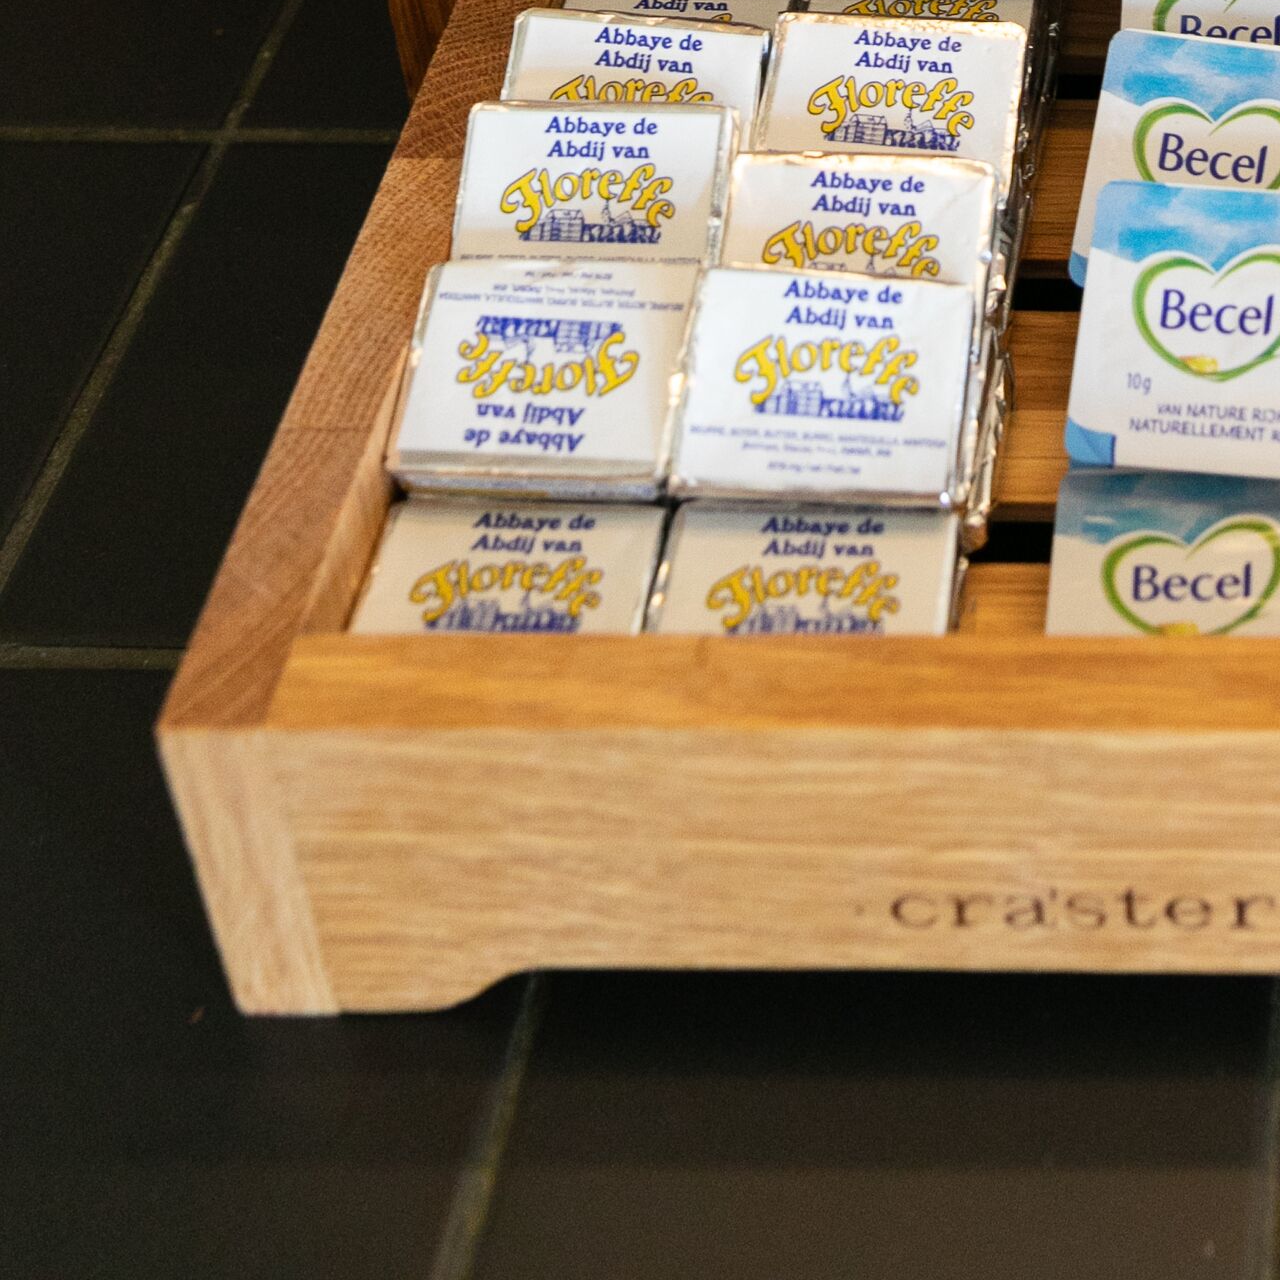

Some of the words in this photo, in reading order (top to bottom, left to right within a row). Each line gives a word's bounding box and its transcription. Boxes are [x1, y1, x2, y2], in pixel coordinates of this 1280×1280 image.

[693, 0, 729, 11] van
[594, 27, 673, 52] Abbaye
[679, 33, 703, 51] de
[854, 29, 932, 52] Abbaye
[938, 36, 962, 53] de
[594, 49, 652, 73] Abdij
[657, 59, 694, 74] van
[854, 51, 911, 74] Abdij
[917, 60, 954, 74] van
[545, 116, 627, 137] Abbaye
[632, 117, 659, 135] de
[547, 140, 606, 161] Abdij
[612, 145, 650, 159] van
[1158, 132, 1268, 185] Becel
[810, 170, 894, 194] Abbaye
[900, 175, 926, 193] de
[812, 193, 872, 217] Abdij
[878, 202, 917, 217] van
[783, 279, 869, 304] Abbaye
[877, 285, 903, 304] de
[785, 306, 847, 330] Abdij
[855, 314, 895, 330] van
[1159, 288, 1274, 336] Becel
[1127, 372, 1152, 394] 10g
[476, 403, 515, 419] van
[523, 402, 585, 427] Abdij
[1157, 403, 1182, 417] VAN
[1186, 404, 1248, 421] NATURE
[464, 427, 491, 448] de
[1129, 416, 1265, 442] NATURELLEMENT
[497, 430, 585, 453] Abbaye
[473, 512, 561, 532] Abbaye
[567, 513, 596, 531] de
[761, 516, 850, 536] Abbaye
[857, 518, 885, 534] de
[472, 534, 537, 554] Abdij
[542, 538, 583, 553] van
[762, 538, 828, 559] Abdij
[833, 542, 874, 557] van
[1131, 561, 1253, 603] Becel
